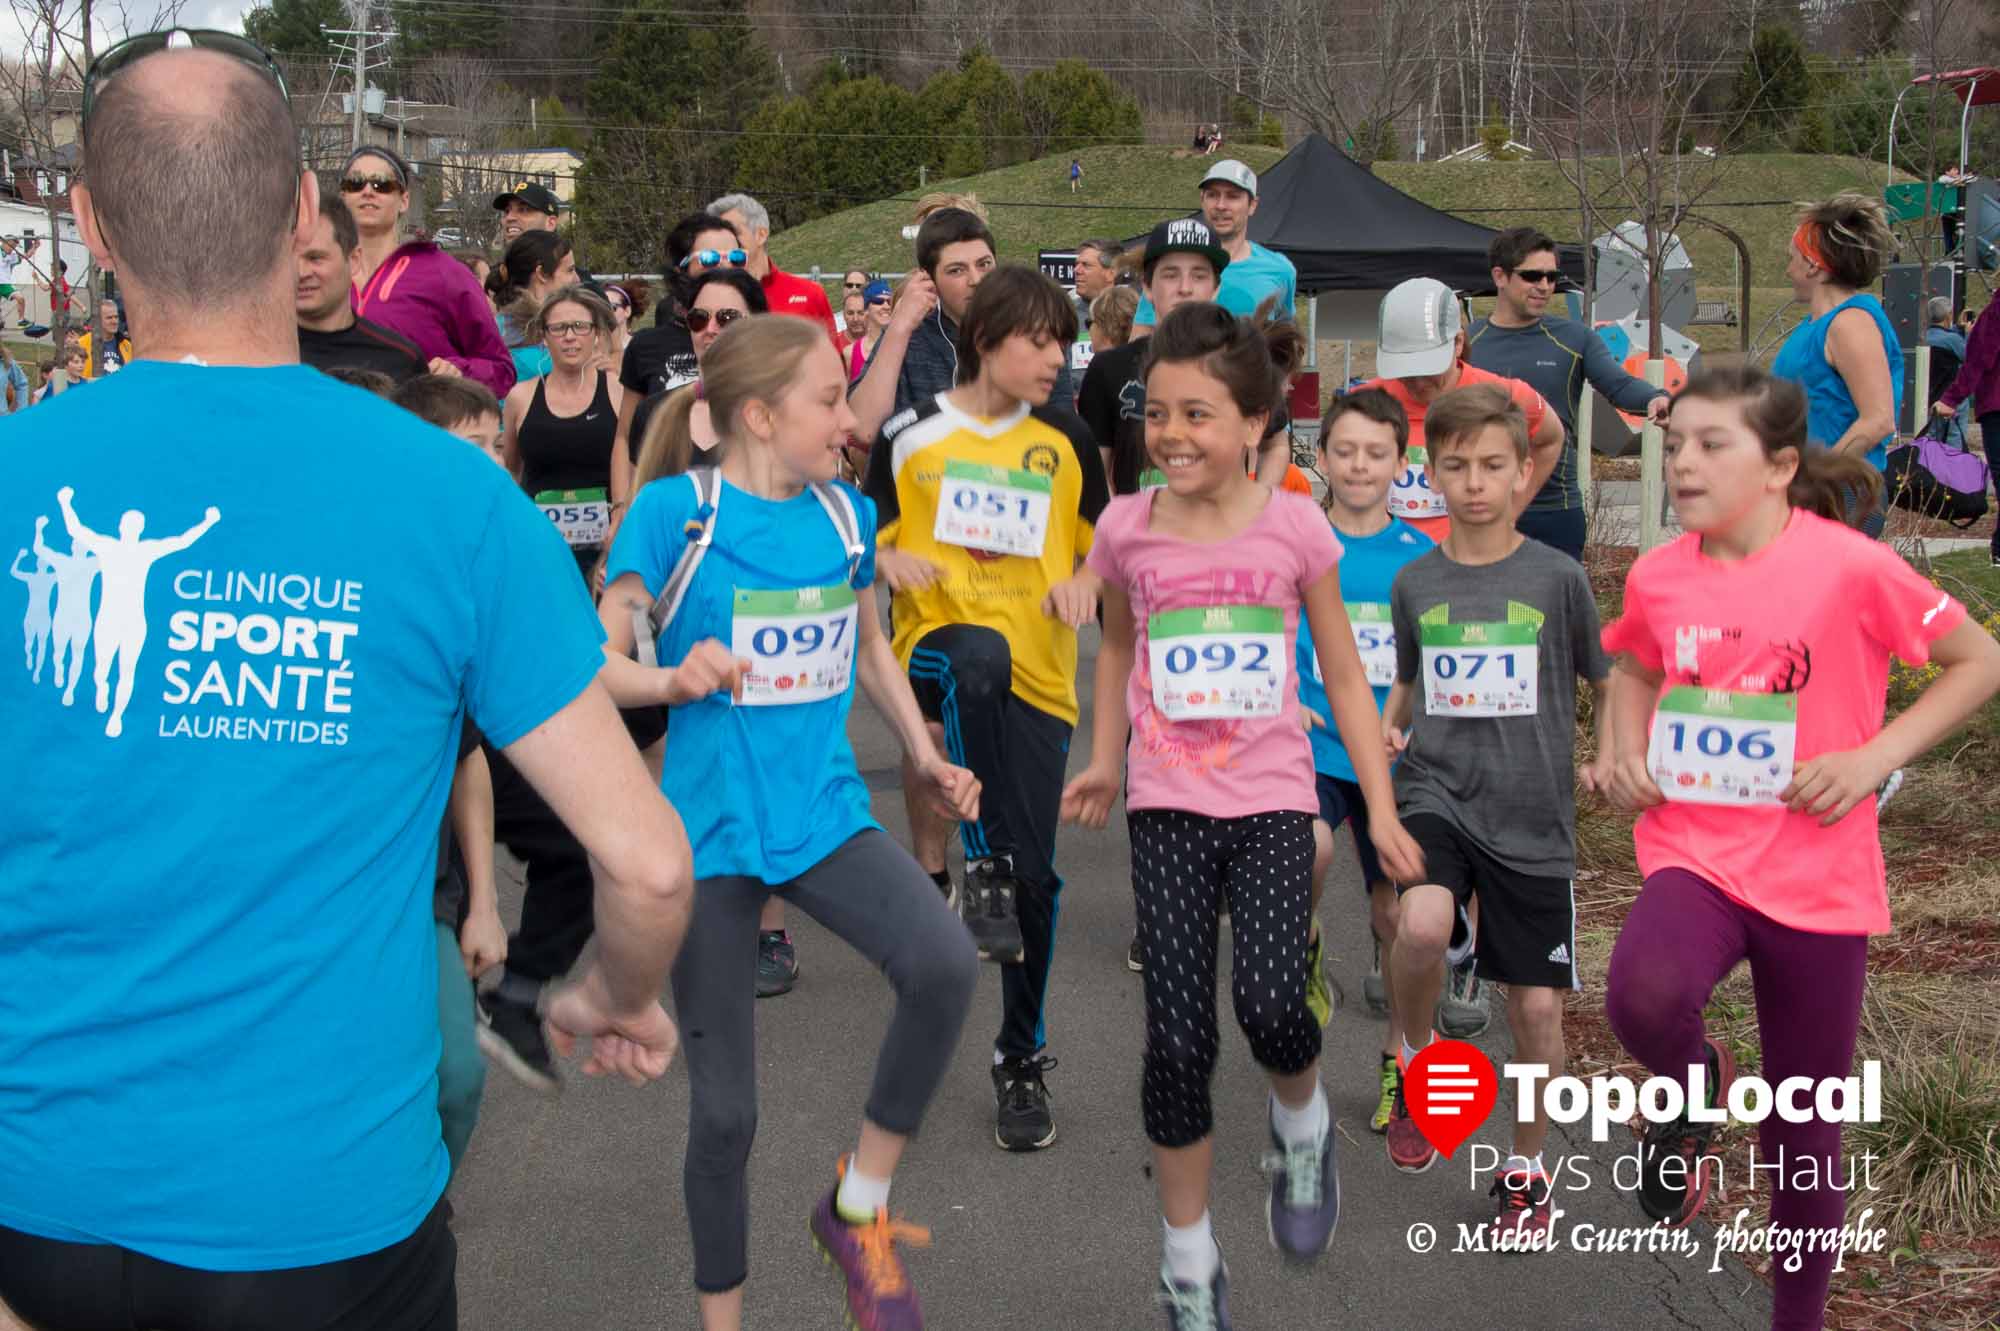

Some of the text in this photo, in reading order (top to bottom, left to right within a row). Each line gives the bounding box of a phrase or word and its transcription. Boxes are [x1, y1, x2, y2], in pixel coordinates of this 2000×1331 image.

[513, 181, 529, 194] P
[1041, 264, 1074, 279] EVEN
[545, 505, 600, 524] 055
[953, 487, 1030, 521] 051
[173, 569, 363, 612] CLINIQUE
[168, 610, 358, 661] SPORT
[752, 614, 849, 658] 097
[1165, 642, 1271, 674] 092
[1434, 653, 1515, 679] 071
[162, 658, 354, 713] SANTÉ
[158, 715, 349, 745] LAURENTIDES
[1667, 721, 1776, 760] 106
